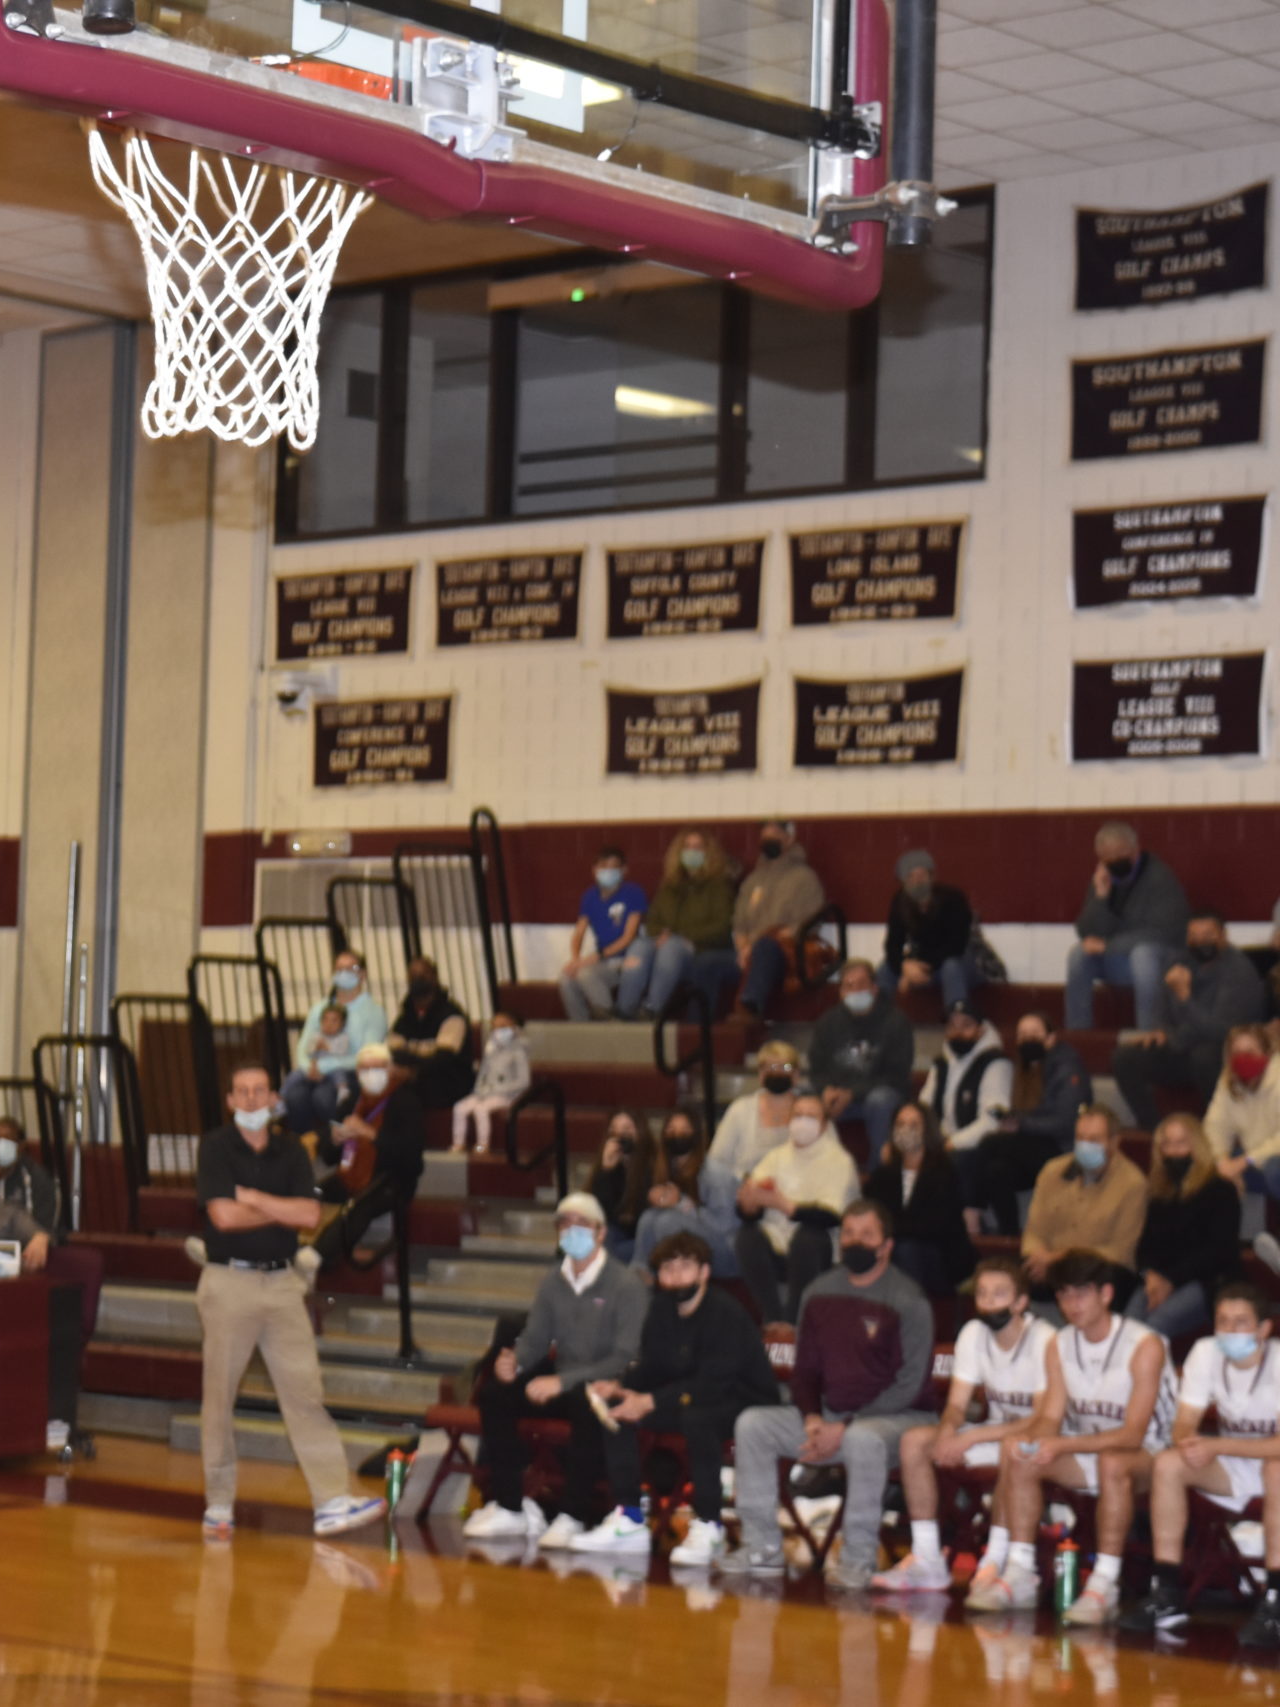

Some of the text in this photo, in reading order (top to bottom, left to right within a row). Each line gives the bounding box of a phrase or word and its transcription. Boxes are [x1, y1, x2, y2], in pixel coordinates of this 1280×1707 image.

[1095, 196, 1245, 235] SOUTHAMPTON
[1114, 246, 1226, 280] GOLF CHAMPS
[1091, 348, 1243, 386] SOUTHAMPTON
[1108, 399, 1220, 430] GOLF CHAMPS
[1113, 503, 1224, 530] SOUTHAMPTON
[826, 553, 920, 576] LONG ISLAND
[1102, 549, 1232, 578] GOLF CHAMPIONS
[688, 570, 737, 590] COUNTY
[811, 575, 936, 606] GOLF CHAMPIONS
[453, 603, 560, 631] GOLF CHAMPIONS
[623, 592, 741, 621] GOLF CHAMPIONS
[292, 615, 394, 643] GOLF CHAMPIONS
[1111, 657, 1224, 682] SOUTHAMPTON
[813, 704, 890, 724] LEAGUE
[1117, 697, 1176, 719] LEAGUE
[337, 726, 404, 747] CONFERENCE
[625, 716, 696, 734] LEAGUE
[815, 719, 937, 747] GOLF CHAMPIONS
[1111, 715, 1220, 740] CO-CHAMPIONS
[329, 744, 431, 772] GOLF CHAMPIONS
[625, 730, 739, 758] GOLF CHAMPIONS
